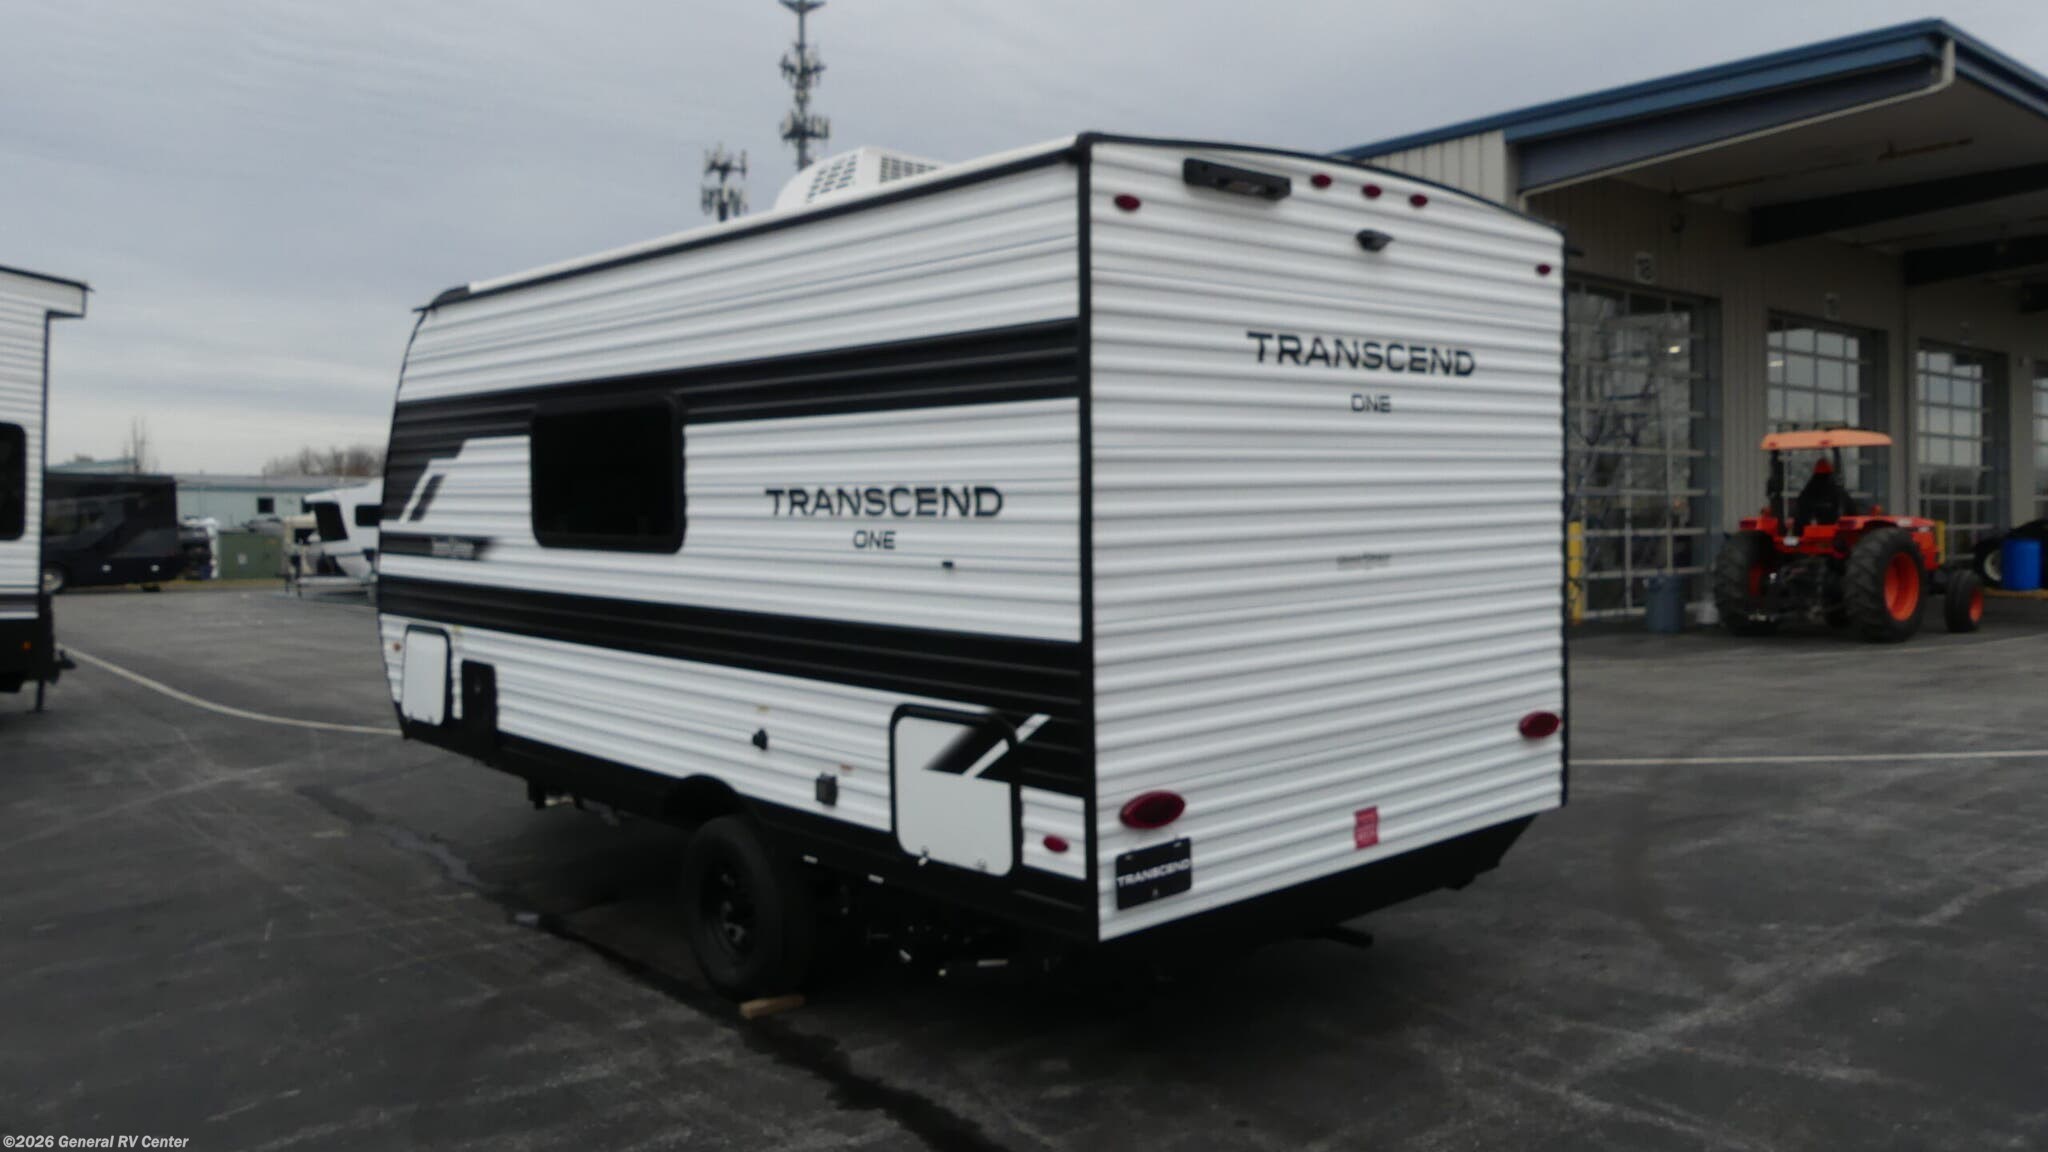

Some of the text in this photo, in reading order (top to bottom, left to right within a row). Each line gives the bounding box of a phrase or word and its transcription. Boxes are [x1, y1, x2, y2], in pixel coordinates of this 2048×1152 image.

[1246, 331, 1477, 377] TRANSCEND
[1351, 393, 1392, 413] ONE
[765, 485, 1004, 518] TRANSCEND
[853, 530, 897, 550] ONE
[1117, 858, 1191, 888] TRANSCEND
